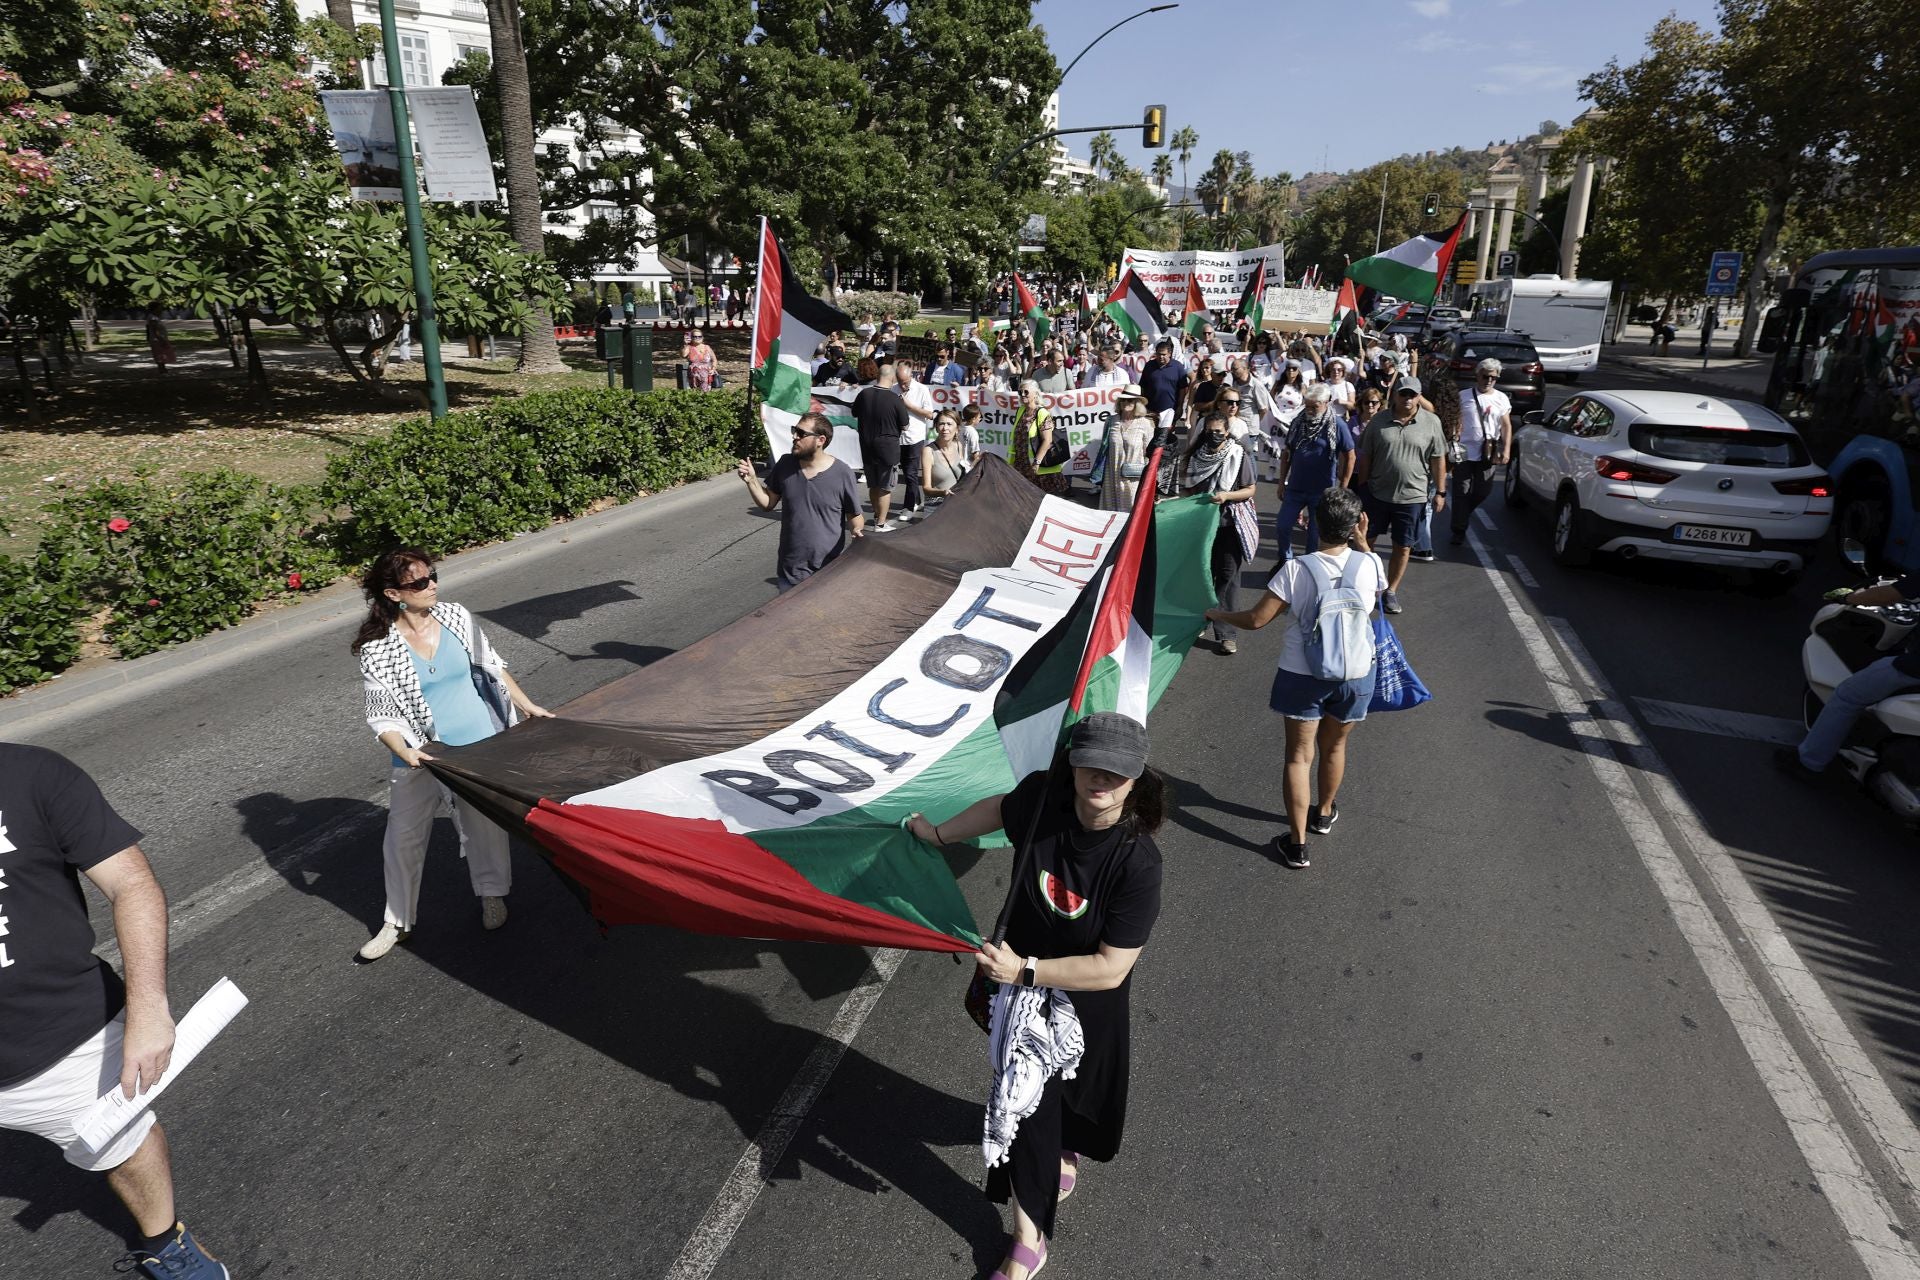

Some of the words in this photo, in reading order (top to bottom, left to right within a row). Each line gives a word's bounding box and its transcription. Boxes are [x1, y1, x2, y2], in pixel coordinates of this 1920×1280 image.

[1500, 256, 1513, 269] P
[1220, 274, 1234, 283] DE
[1238, 268, 1278, 282] ISEL
[1200, 286, 1228, 294] PARA
[933, 388, 960, 405] OS
[969, 390, 989, 406] EL
[995, 387, 1124, 411] GEOCIDIO
[1685, 528, 1717, 541] 4268
[1721, 531, 1746, 543] KVX
[701, 586, 1042, 815] BOICOT
[1029, 513, 1117, 590] AEL
